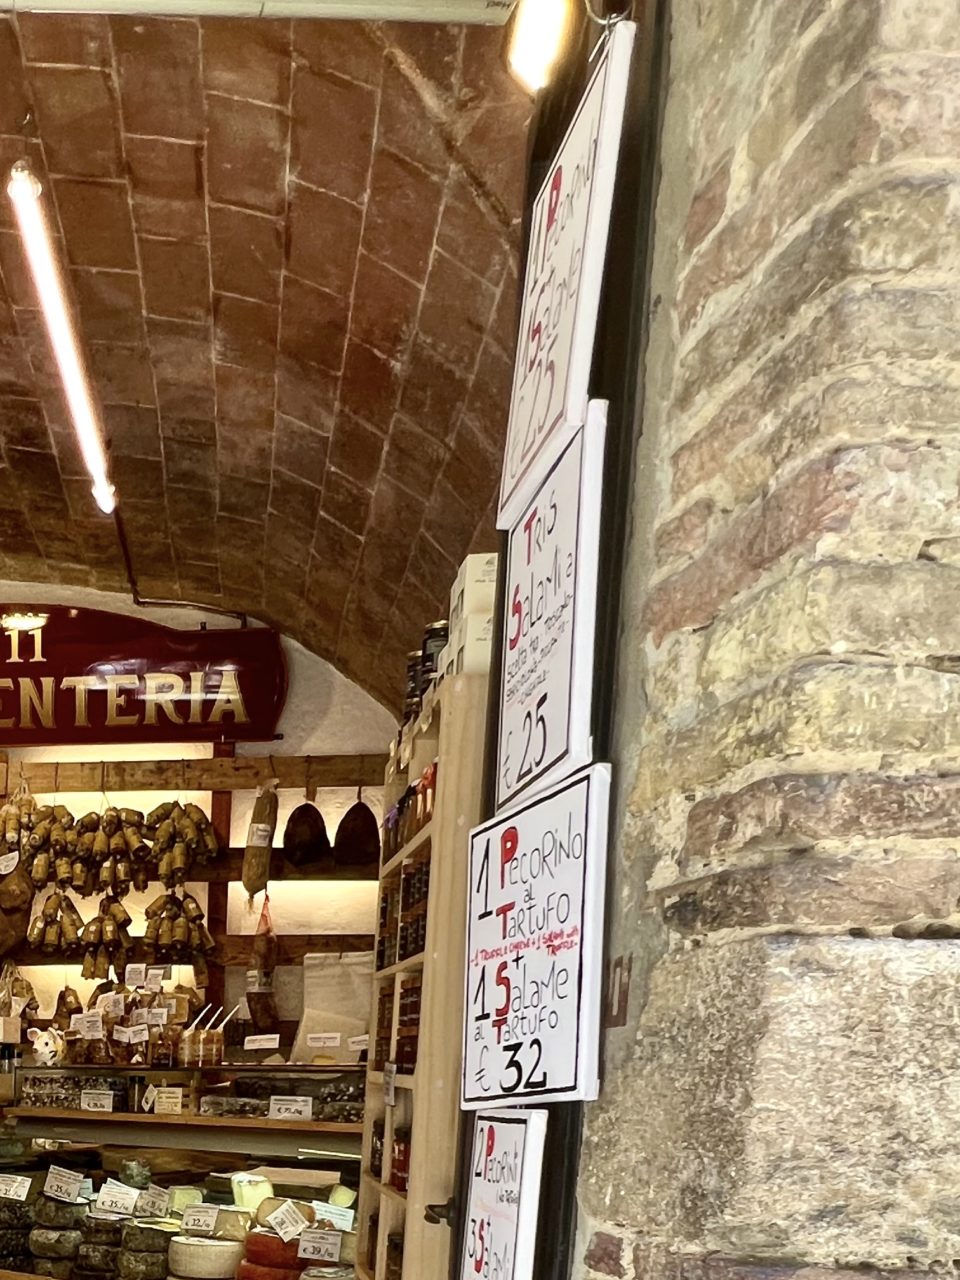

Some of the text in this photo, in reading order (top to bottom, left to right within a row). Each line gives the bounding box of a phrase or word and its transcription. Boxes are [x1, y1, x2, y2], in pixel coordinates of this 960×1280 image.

[516, 692, 548, 784] 25
[476, 838, 493, 920] 1
[522, 886, 535, 903] al
[474, 964, 490, 1022] 1
[474, 1037, 547, 1094] € 32
[474, 1127, 484, 1178] 2
[467, 1218, 477, 1259] 3
